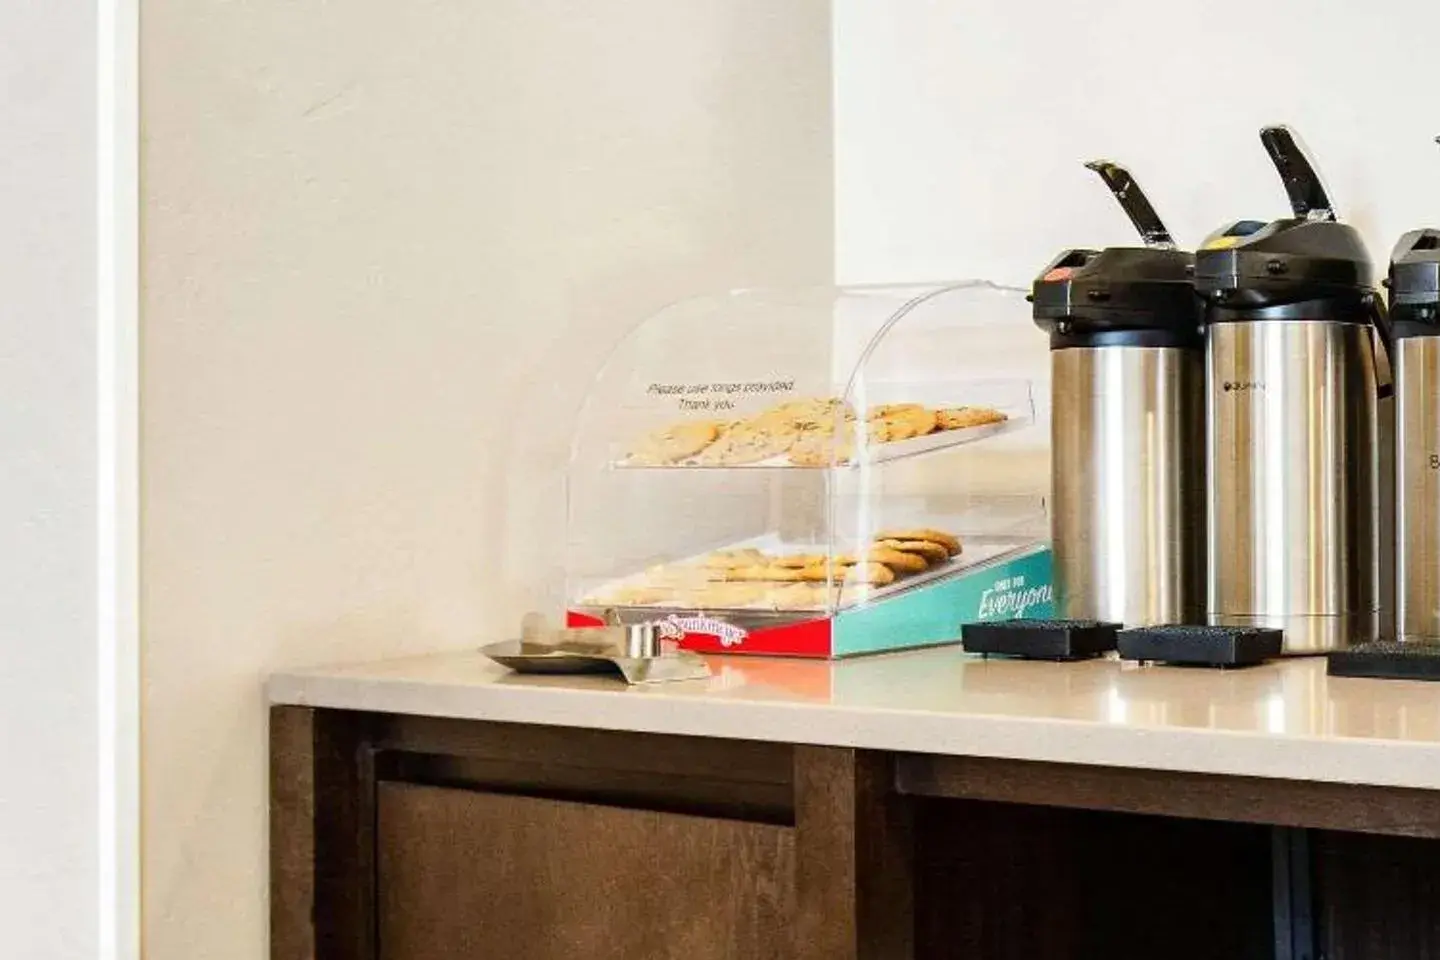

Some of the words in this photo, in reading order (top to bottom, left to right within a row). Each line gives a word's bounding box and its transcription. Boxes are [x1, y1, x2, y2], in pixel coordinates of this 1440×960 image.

[646, 383, 685, 395] Please
[687, 384, 709, 394] use
[710, 382, 742, 395] tongs
[743, 379, 796, 395] provided
[678, 398, 709, 410] Thank
